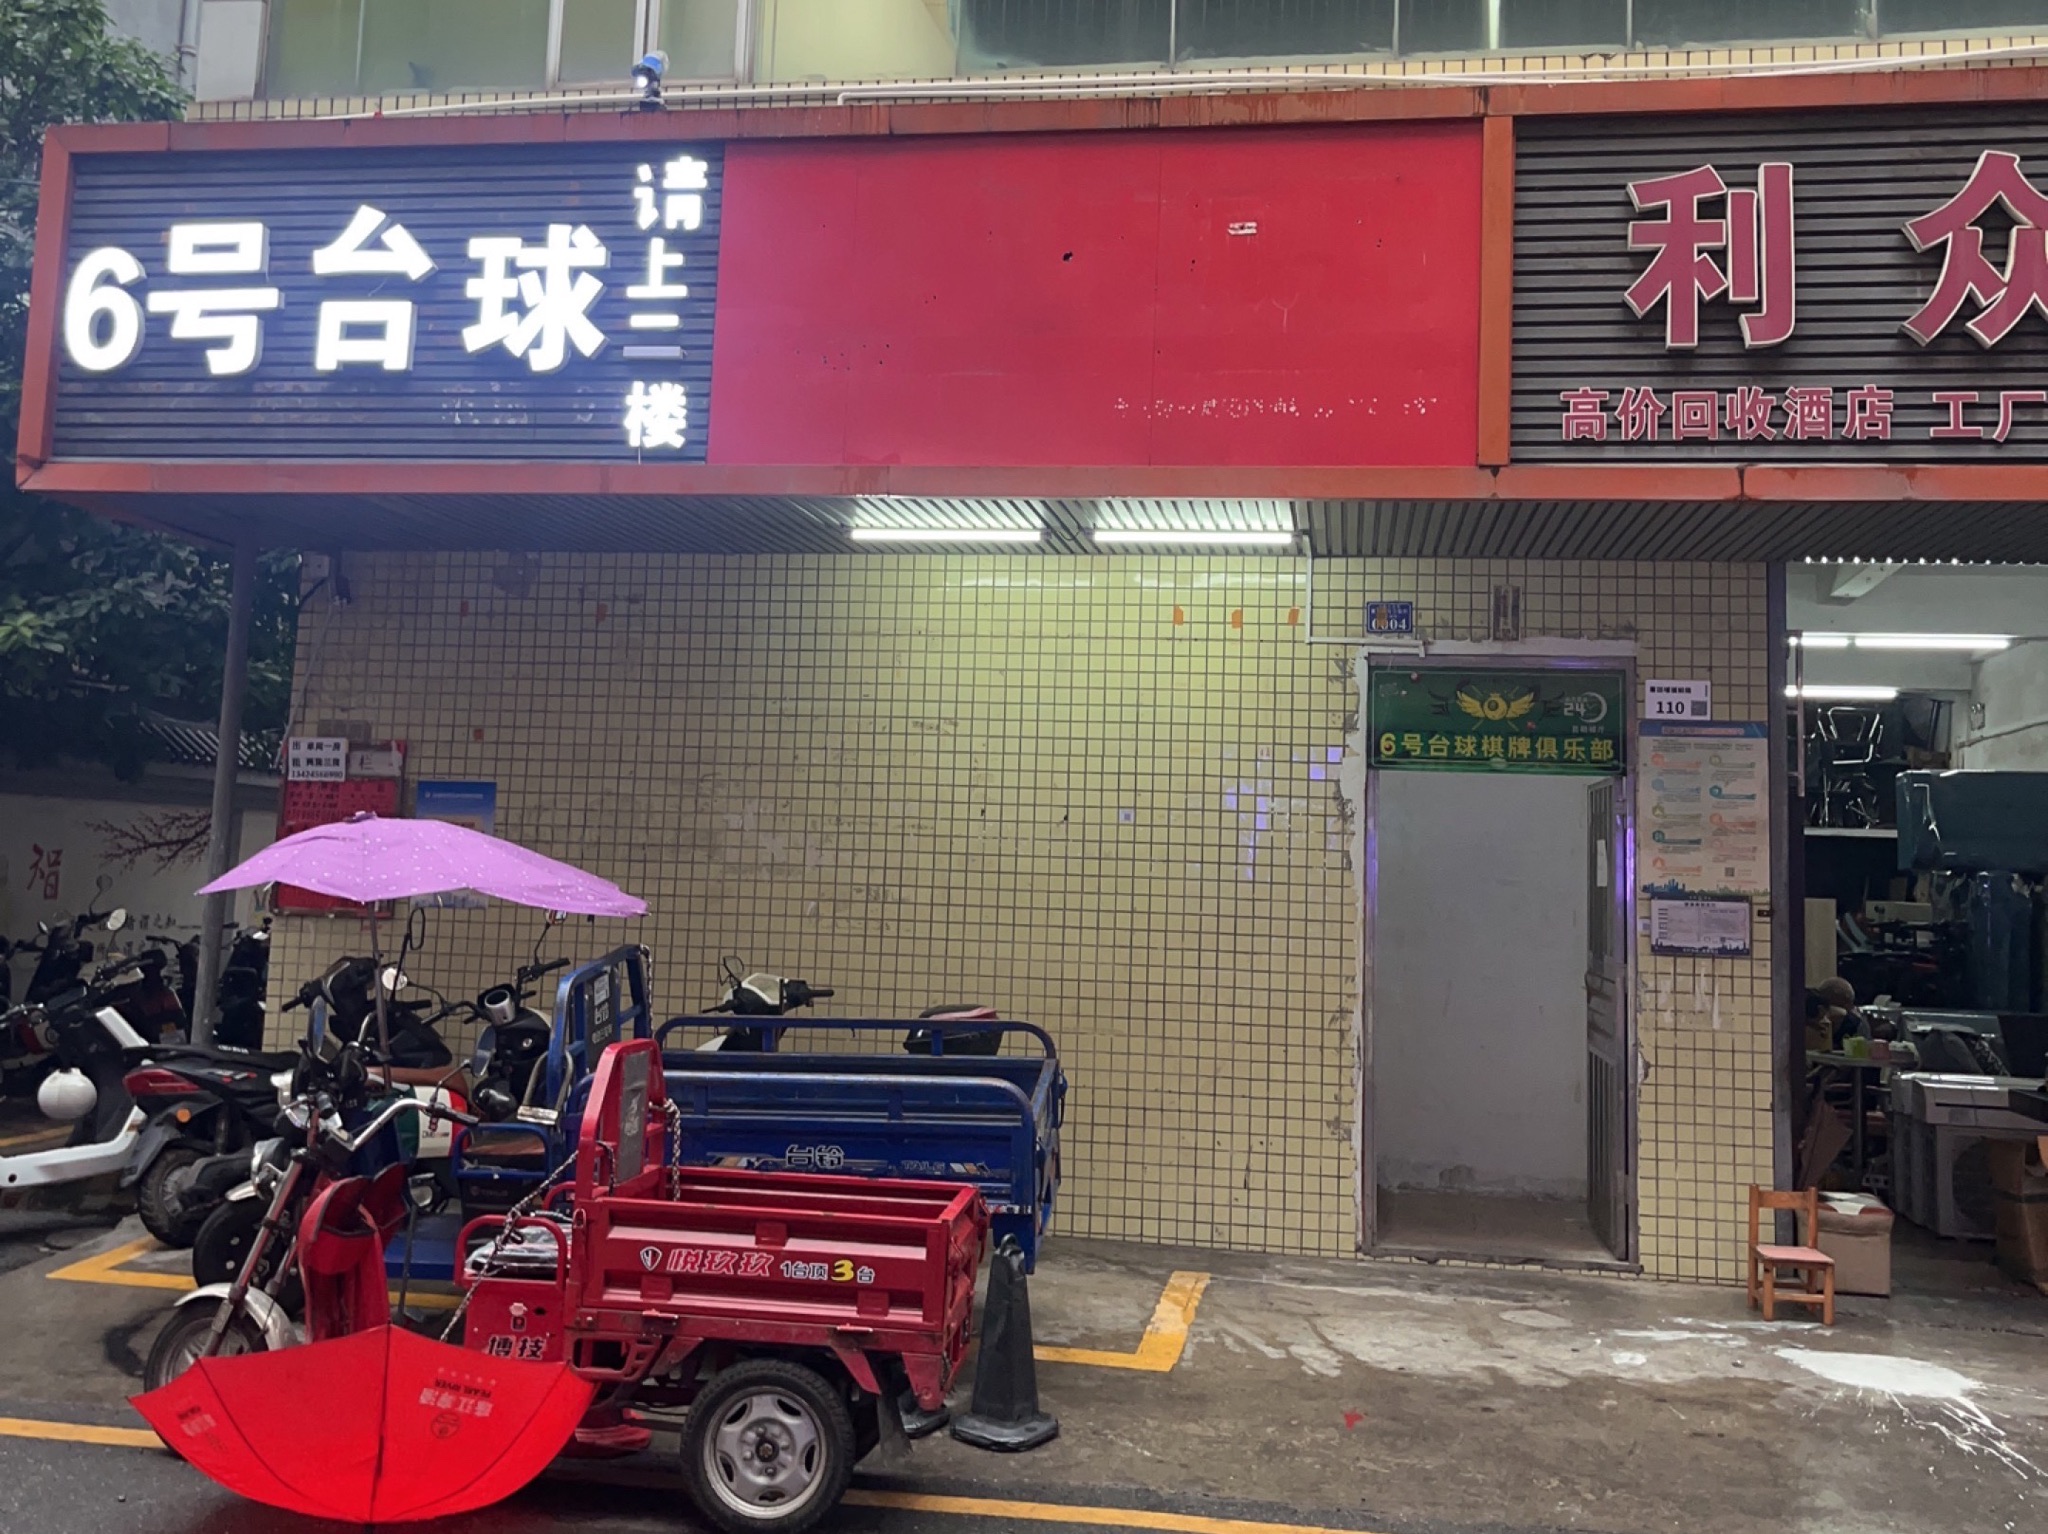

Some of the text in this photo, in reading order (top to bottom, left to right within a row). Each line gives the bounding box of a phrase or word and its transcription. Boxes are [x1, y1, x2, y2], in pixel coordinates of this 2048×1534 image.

[1623, 150, 2048, 348] 利众
[63, 204, 610, 376] 6号台球
[623, 156, 708, 448] 请上二楼
[1560, 385, 2047, 442] 高价回收酒店 工厂
[1564, 703, 1586, 717] 24
[1656, 701, 1685, 714] 110
[1380, 733, 1614, 761] 6号台球棋牌俱乐部
[785, 1144, 844, 1168] 台铃
[667, 1248, 774, 1277] 悦玖玖
[780, 1259, 875, 1283] 1台顶3台
